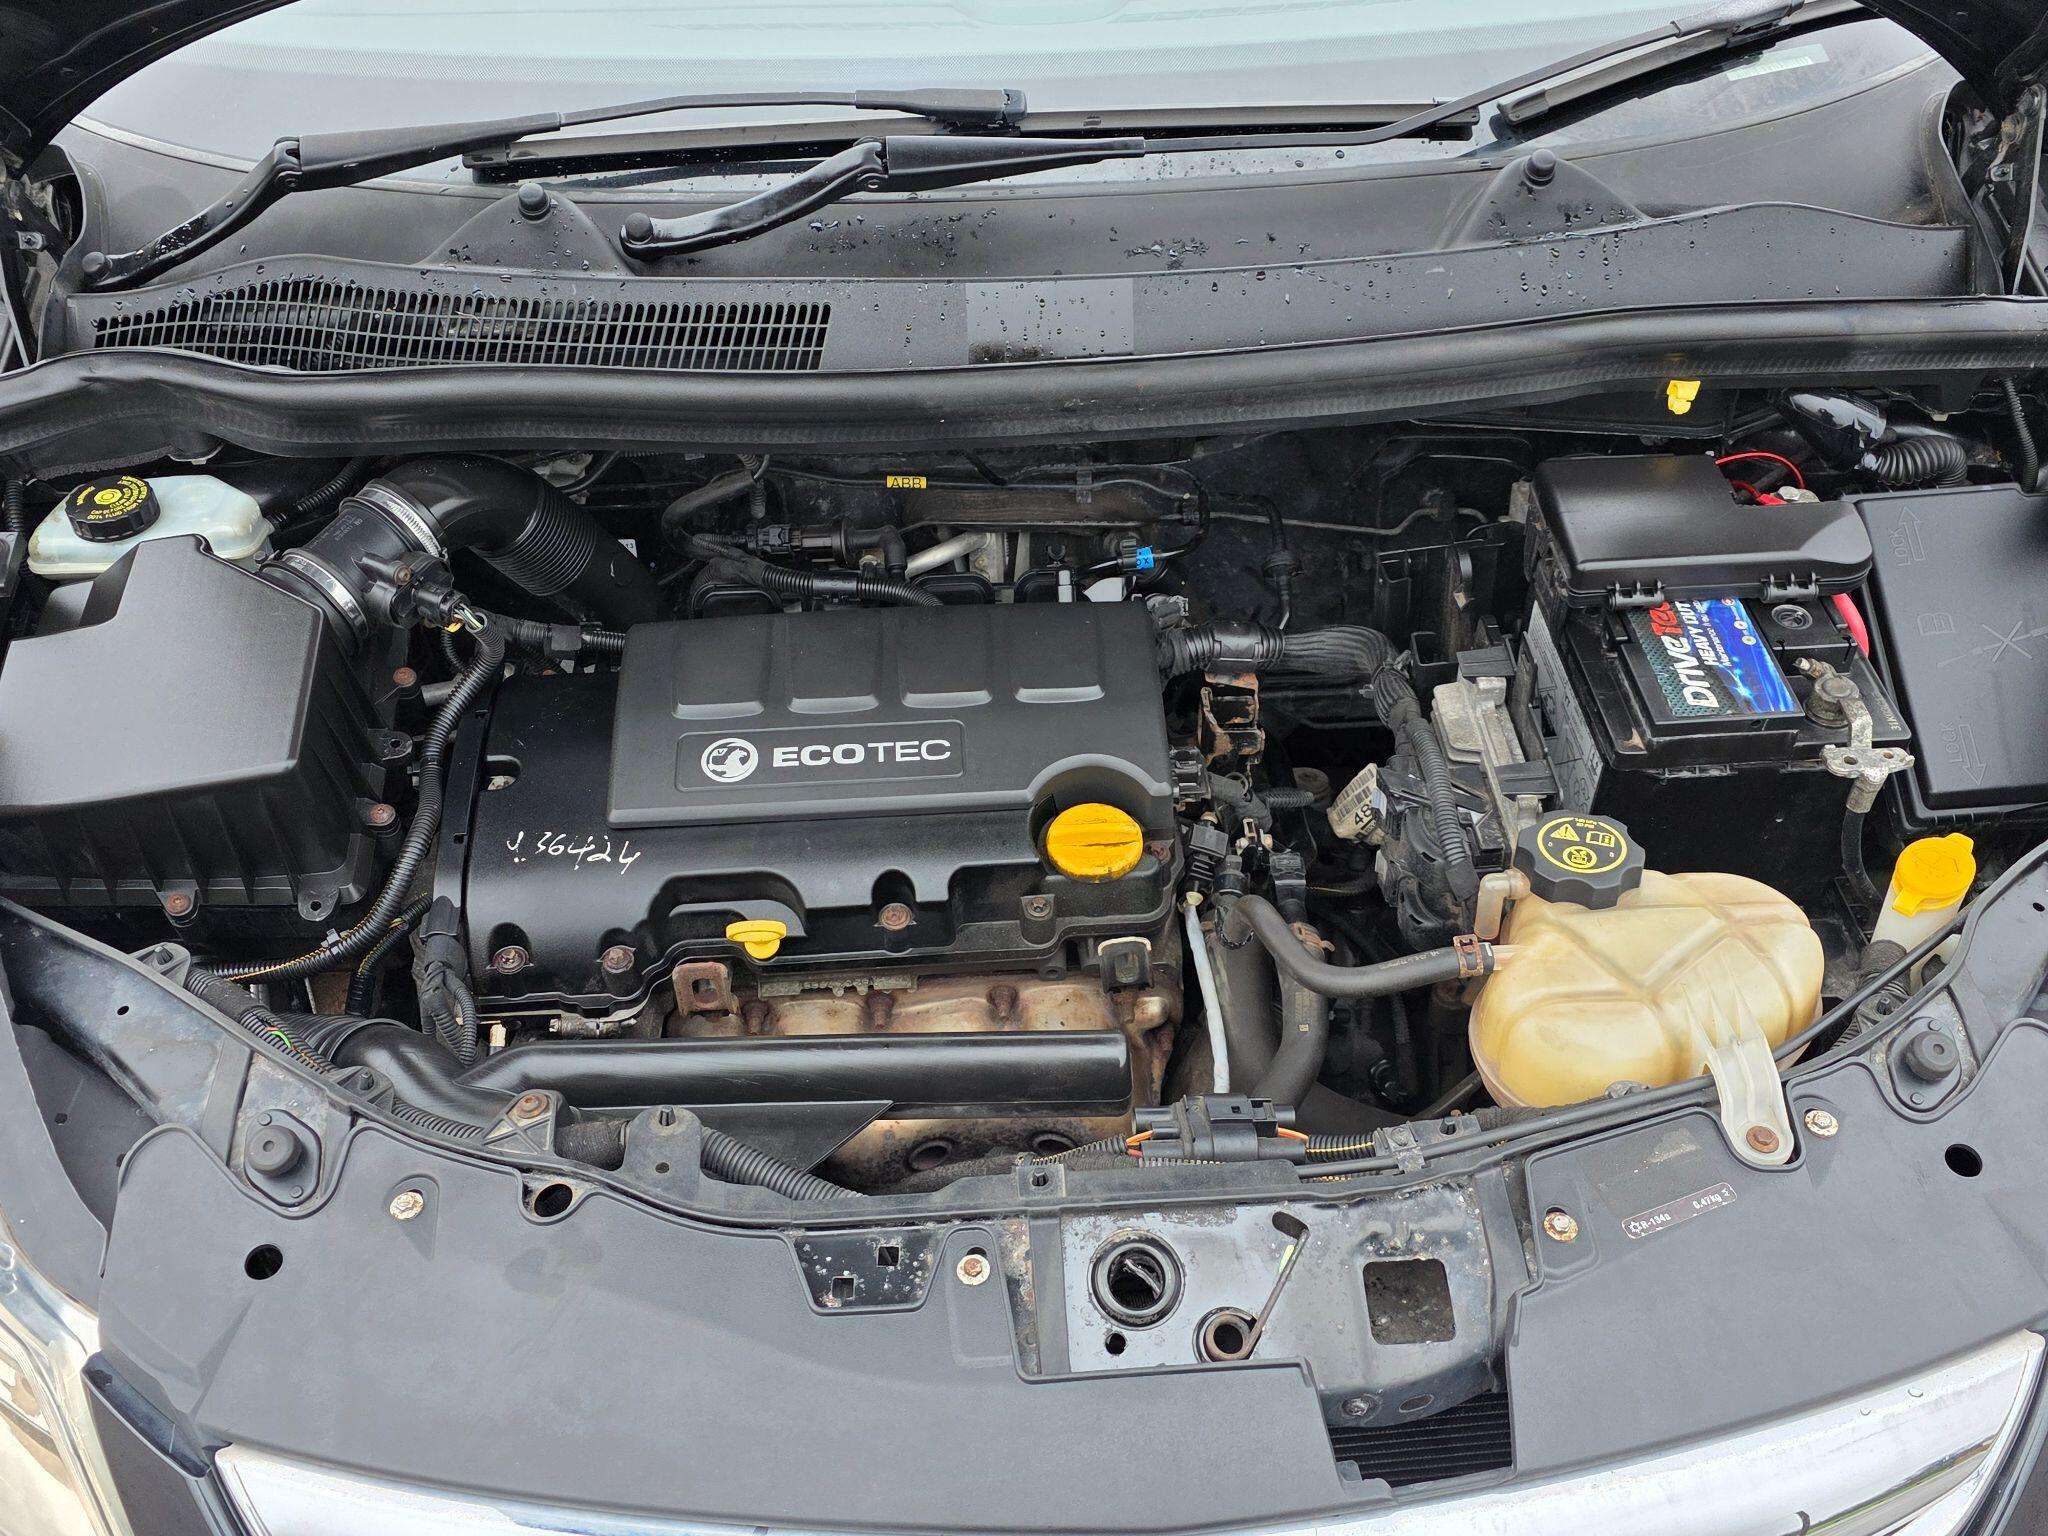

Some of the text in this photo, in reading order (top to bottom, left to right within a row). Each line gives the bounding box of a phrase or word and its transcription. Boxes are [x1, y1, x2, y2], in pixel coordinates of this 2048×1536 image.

[1687, 626, 1721, 667] HEAVY
[772, 739, 952, 768] ECOTEC
[1939, 720, 1965, 764] LOCK
